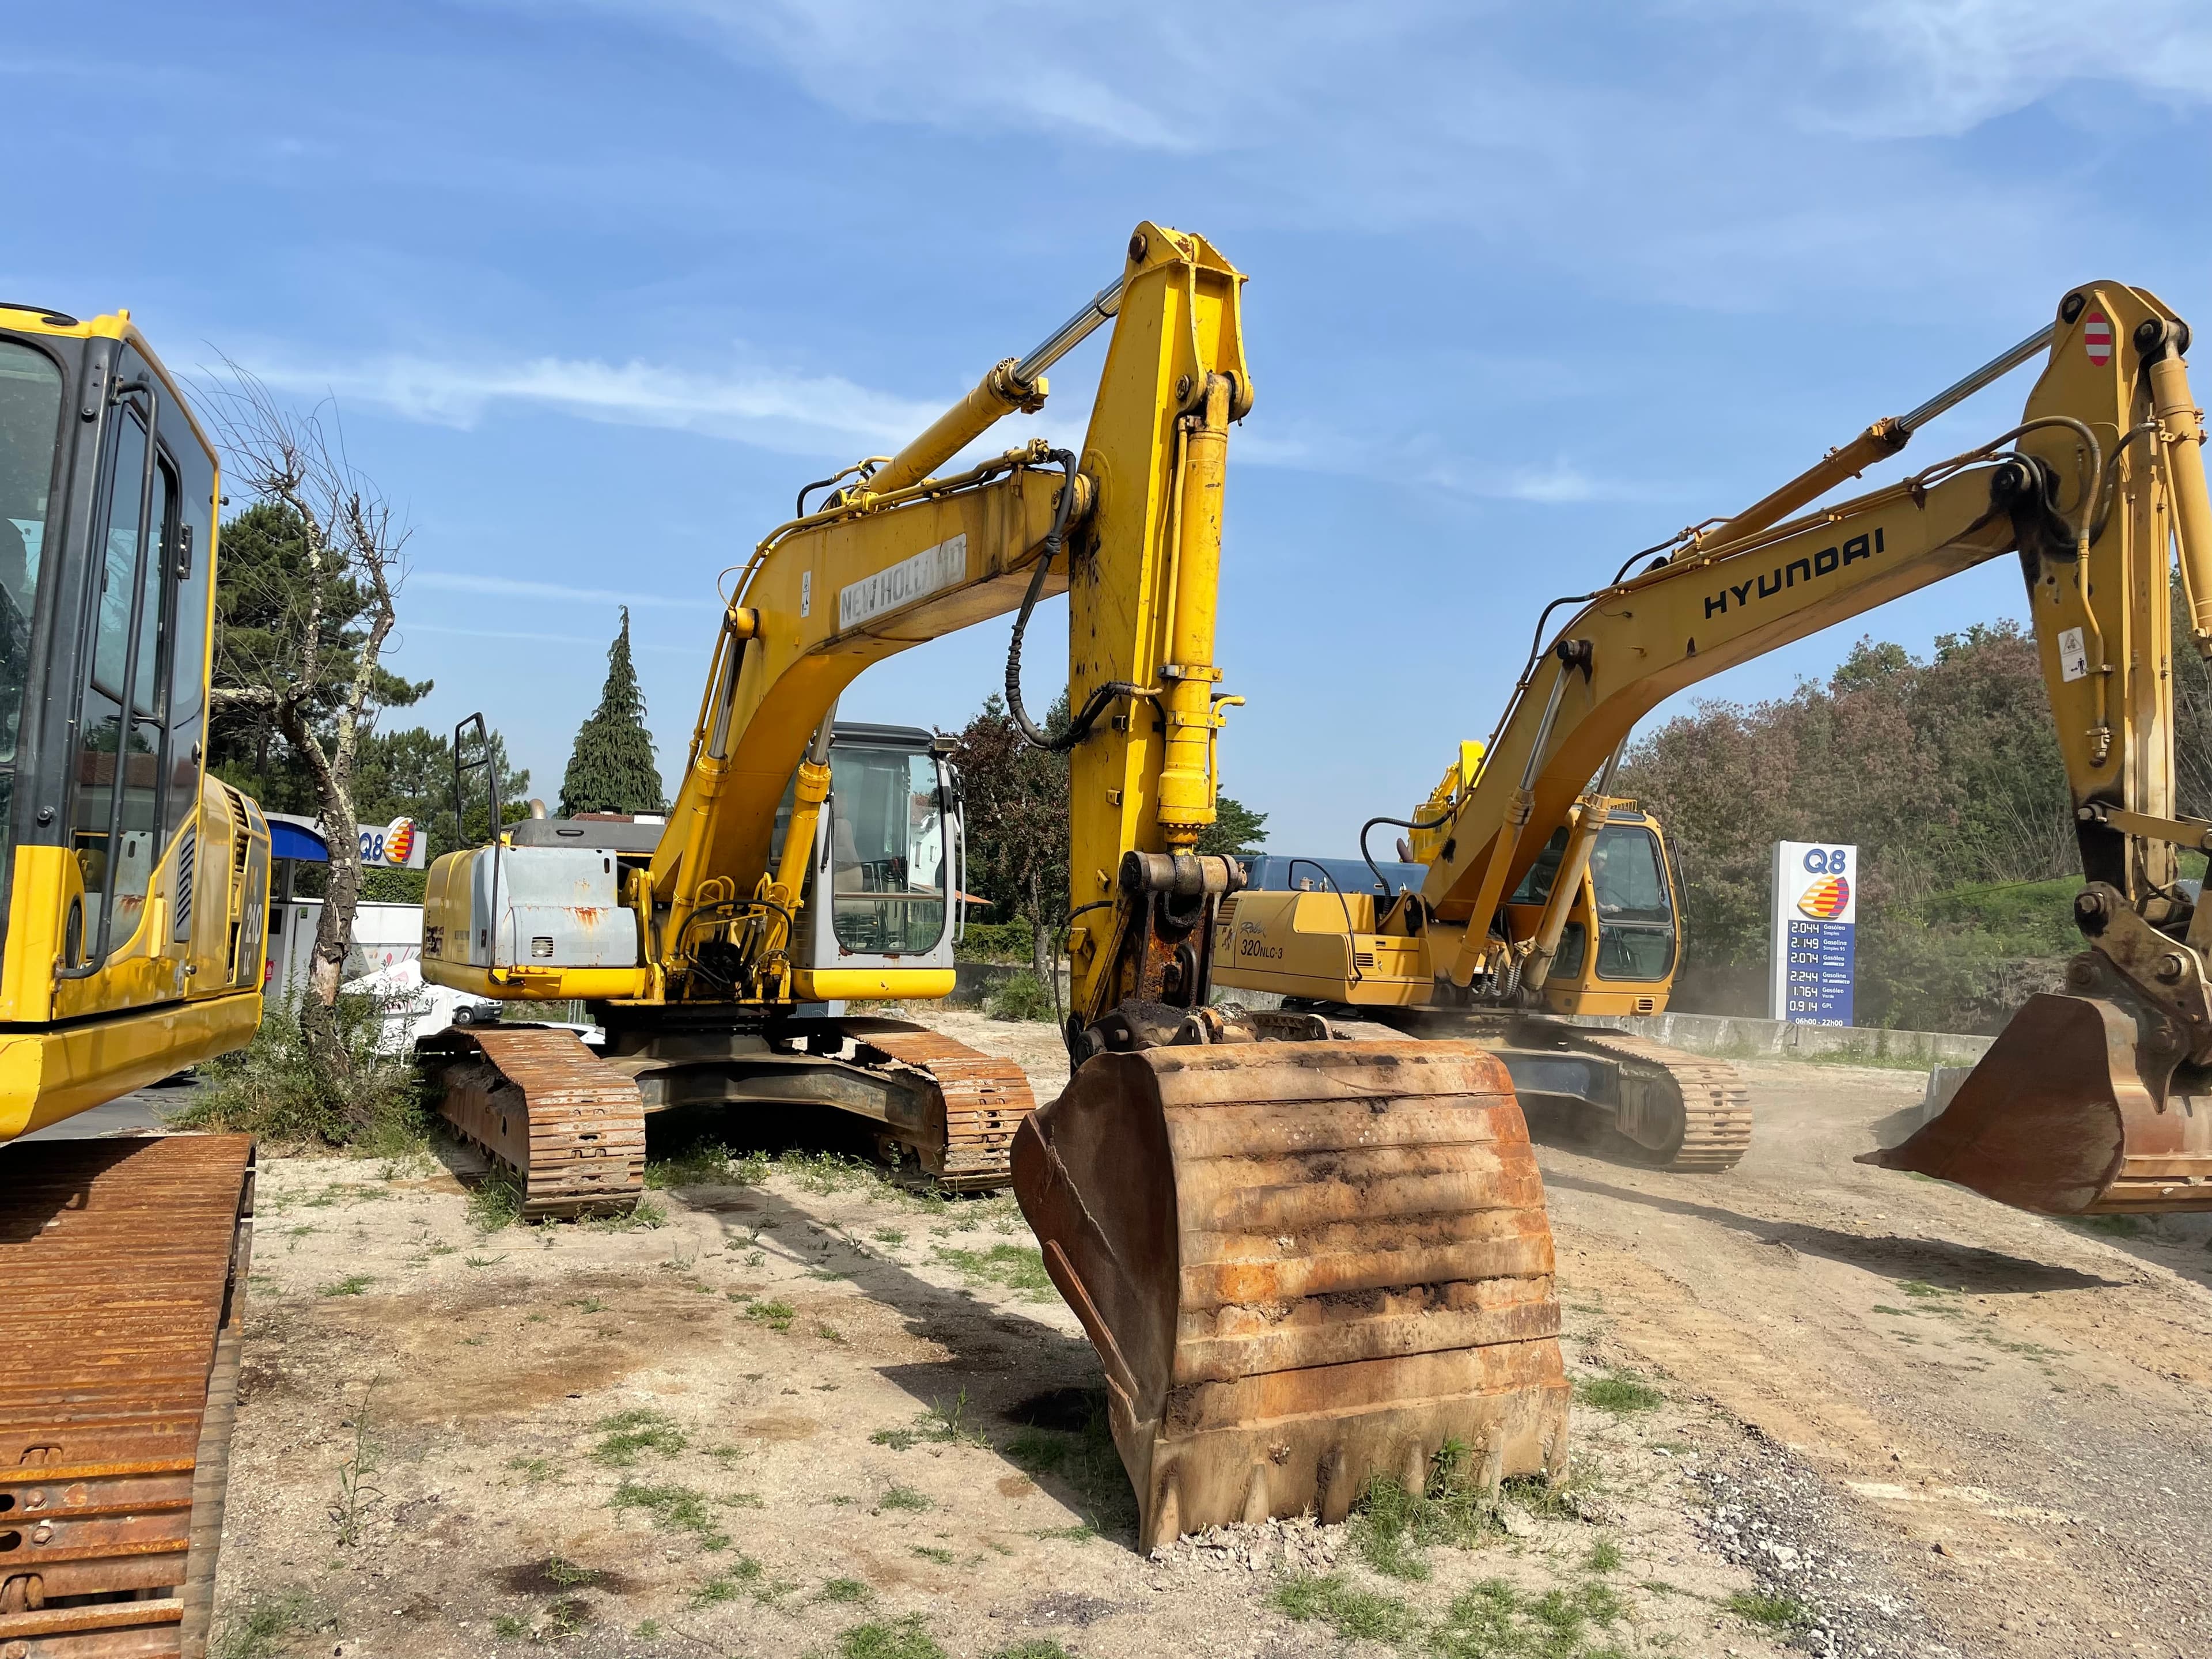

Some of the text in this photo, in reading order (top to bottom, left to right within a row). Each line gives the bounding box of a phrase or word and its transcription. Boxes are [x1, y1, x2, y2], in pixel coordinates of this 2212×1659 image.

[1704, 527, 1884, 619] HYUNDAI
[842, 576, 877, 622] NEW
[359, 832, 383, 861] Q8
[1804, 849, 1846, 874] Q8
[245, 903, 262, 944] 210
[1791, 922, 1819, 933] 2.044
[1791, 937, 1819, 949] 2.149
[1791, 952, 1818, 963] 2.074
[1790, 971, 1818, 982] 2.244
[1794, 986, 1817, 997] 1.764
[1790, 1001, 1817, 1012] 0.914
